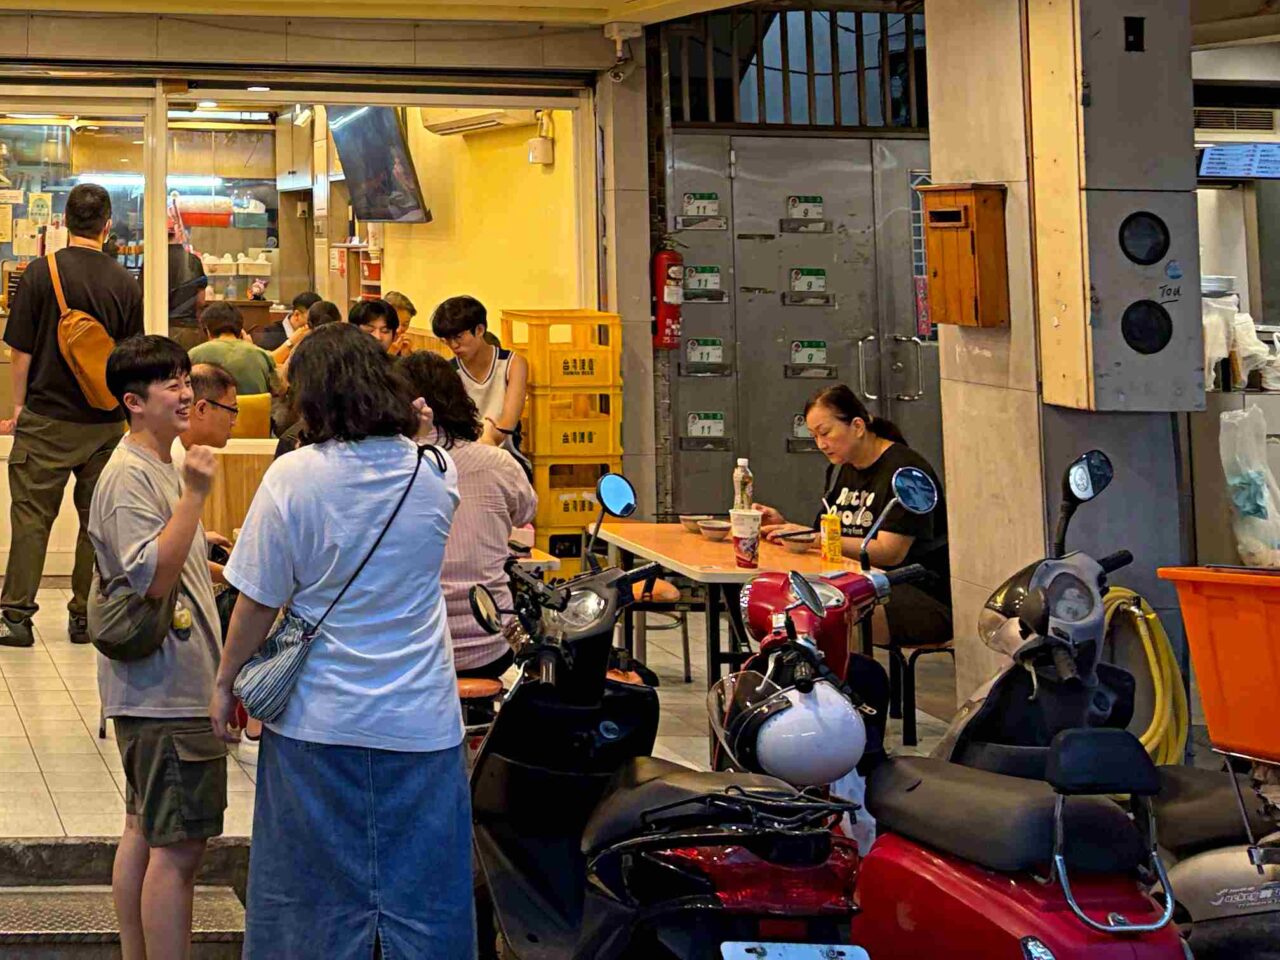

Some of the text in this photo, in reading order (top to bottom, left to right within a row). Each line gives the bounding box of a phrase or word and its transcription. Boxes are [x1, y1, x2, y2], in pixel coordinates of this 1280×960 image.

[696, 205, 707, 215] 11
[697, 278, 708, 288] 11
[699, 351, 710, 361] 11
[701, 425, 711, 434] 11
